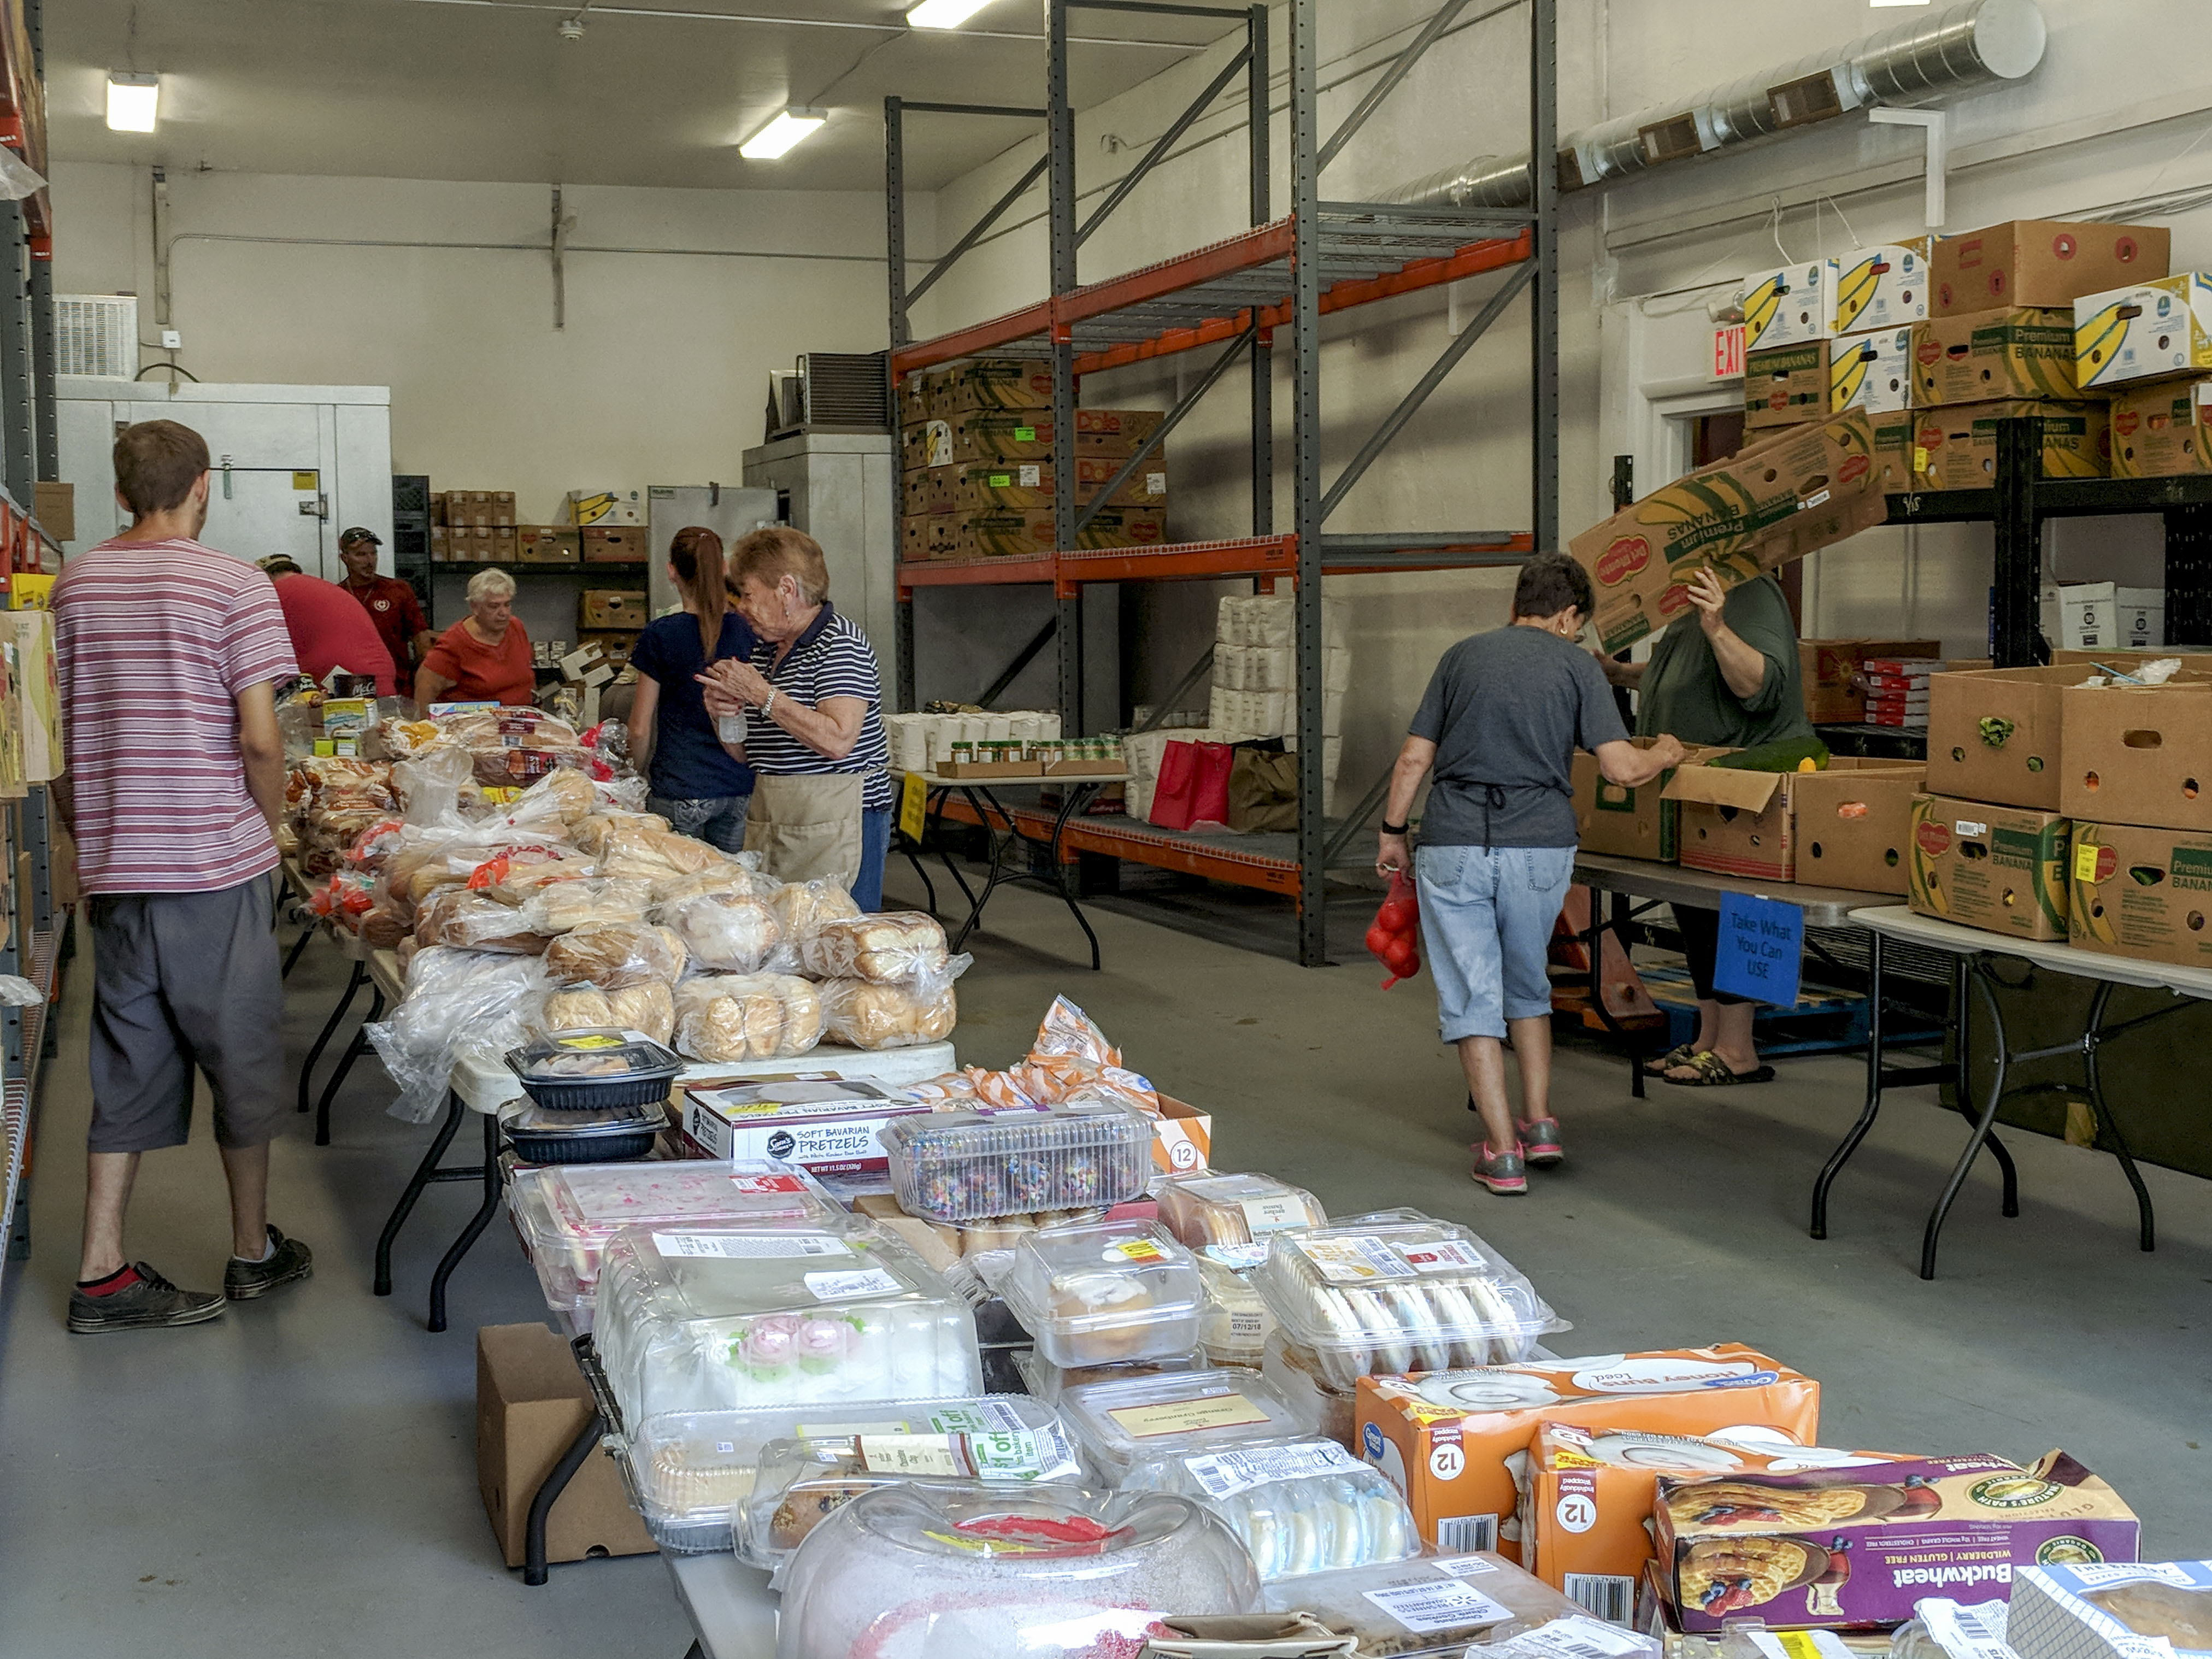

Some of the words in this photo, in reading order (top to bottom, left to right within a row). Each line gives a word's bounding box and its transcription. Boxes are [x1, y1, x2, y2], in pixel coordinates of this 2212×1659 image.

[2015, 329, 2070, 343] Premium
[1715, 326, 1746, 376] EXIT
[2015, 344, 2077, 360] BANANAS
[1667, 503, 1740, 541] BNANAS
[1681, 519, 1744, 549] Premium
[1731, 911, 1757, 932] Take
[1760, 918, 1791, 940] What
[1736, 935, 1758, 955] You
[1761, 940, 1784, 960] Can
[1747, 959, 1769, 980] USE
[797, 1129, 821, 1139] SOFT
[825, 1126, 870, 1137] BAVARIAN
[798, 1136, 869, 1152] PRETZELS
[1176, 1148, 1192, 1163] 12
[1592, 1372, 1633, 1382] Iced
[1601, 1376, 1658, 1387] Buns
[1663, 1370, 1738, 1383] Honey
[1432, 1435, 1462, 1444] Individually
[1025, 1441, 1034, 1457] item
[991, 1456, 1014, 1468] $1
[1437, 1452, 1457, 1471] 12
[1560, 1484, 1595, 1493] Individually
[1562, 1478, 1592, 1486] Wrapped
[2011, 1482, 2061, 1507] NATURE'S
[1978, 1496, 2007, 1508] PATH
[1564, 1503, 1587, 1524] 12
[1884, 1555, 1908, 1565] FREE
[1910, 1552, 1948, 1563] GLUTEN
[1956, 1549, 2012, 1561] WILDBERRY
[1893, 1562, 2013, 1589] Buckwheat
[1393, 1598, 1448, 1609] GUARANTEED
[1397, 1602, 1454, 1613] FRESHNESS
[1434, 1614, 1483, 1624] Chocolate
[1457, 1609, 1489, 1619] Chunk
